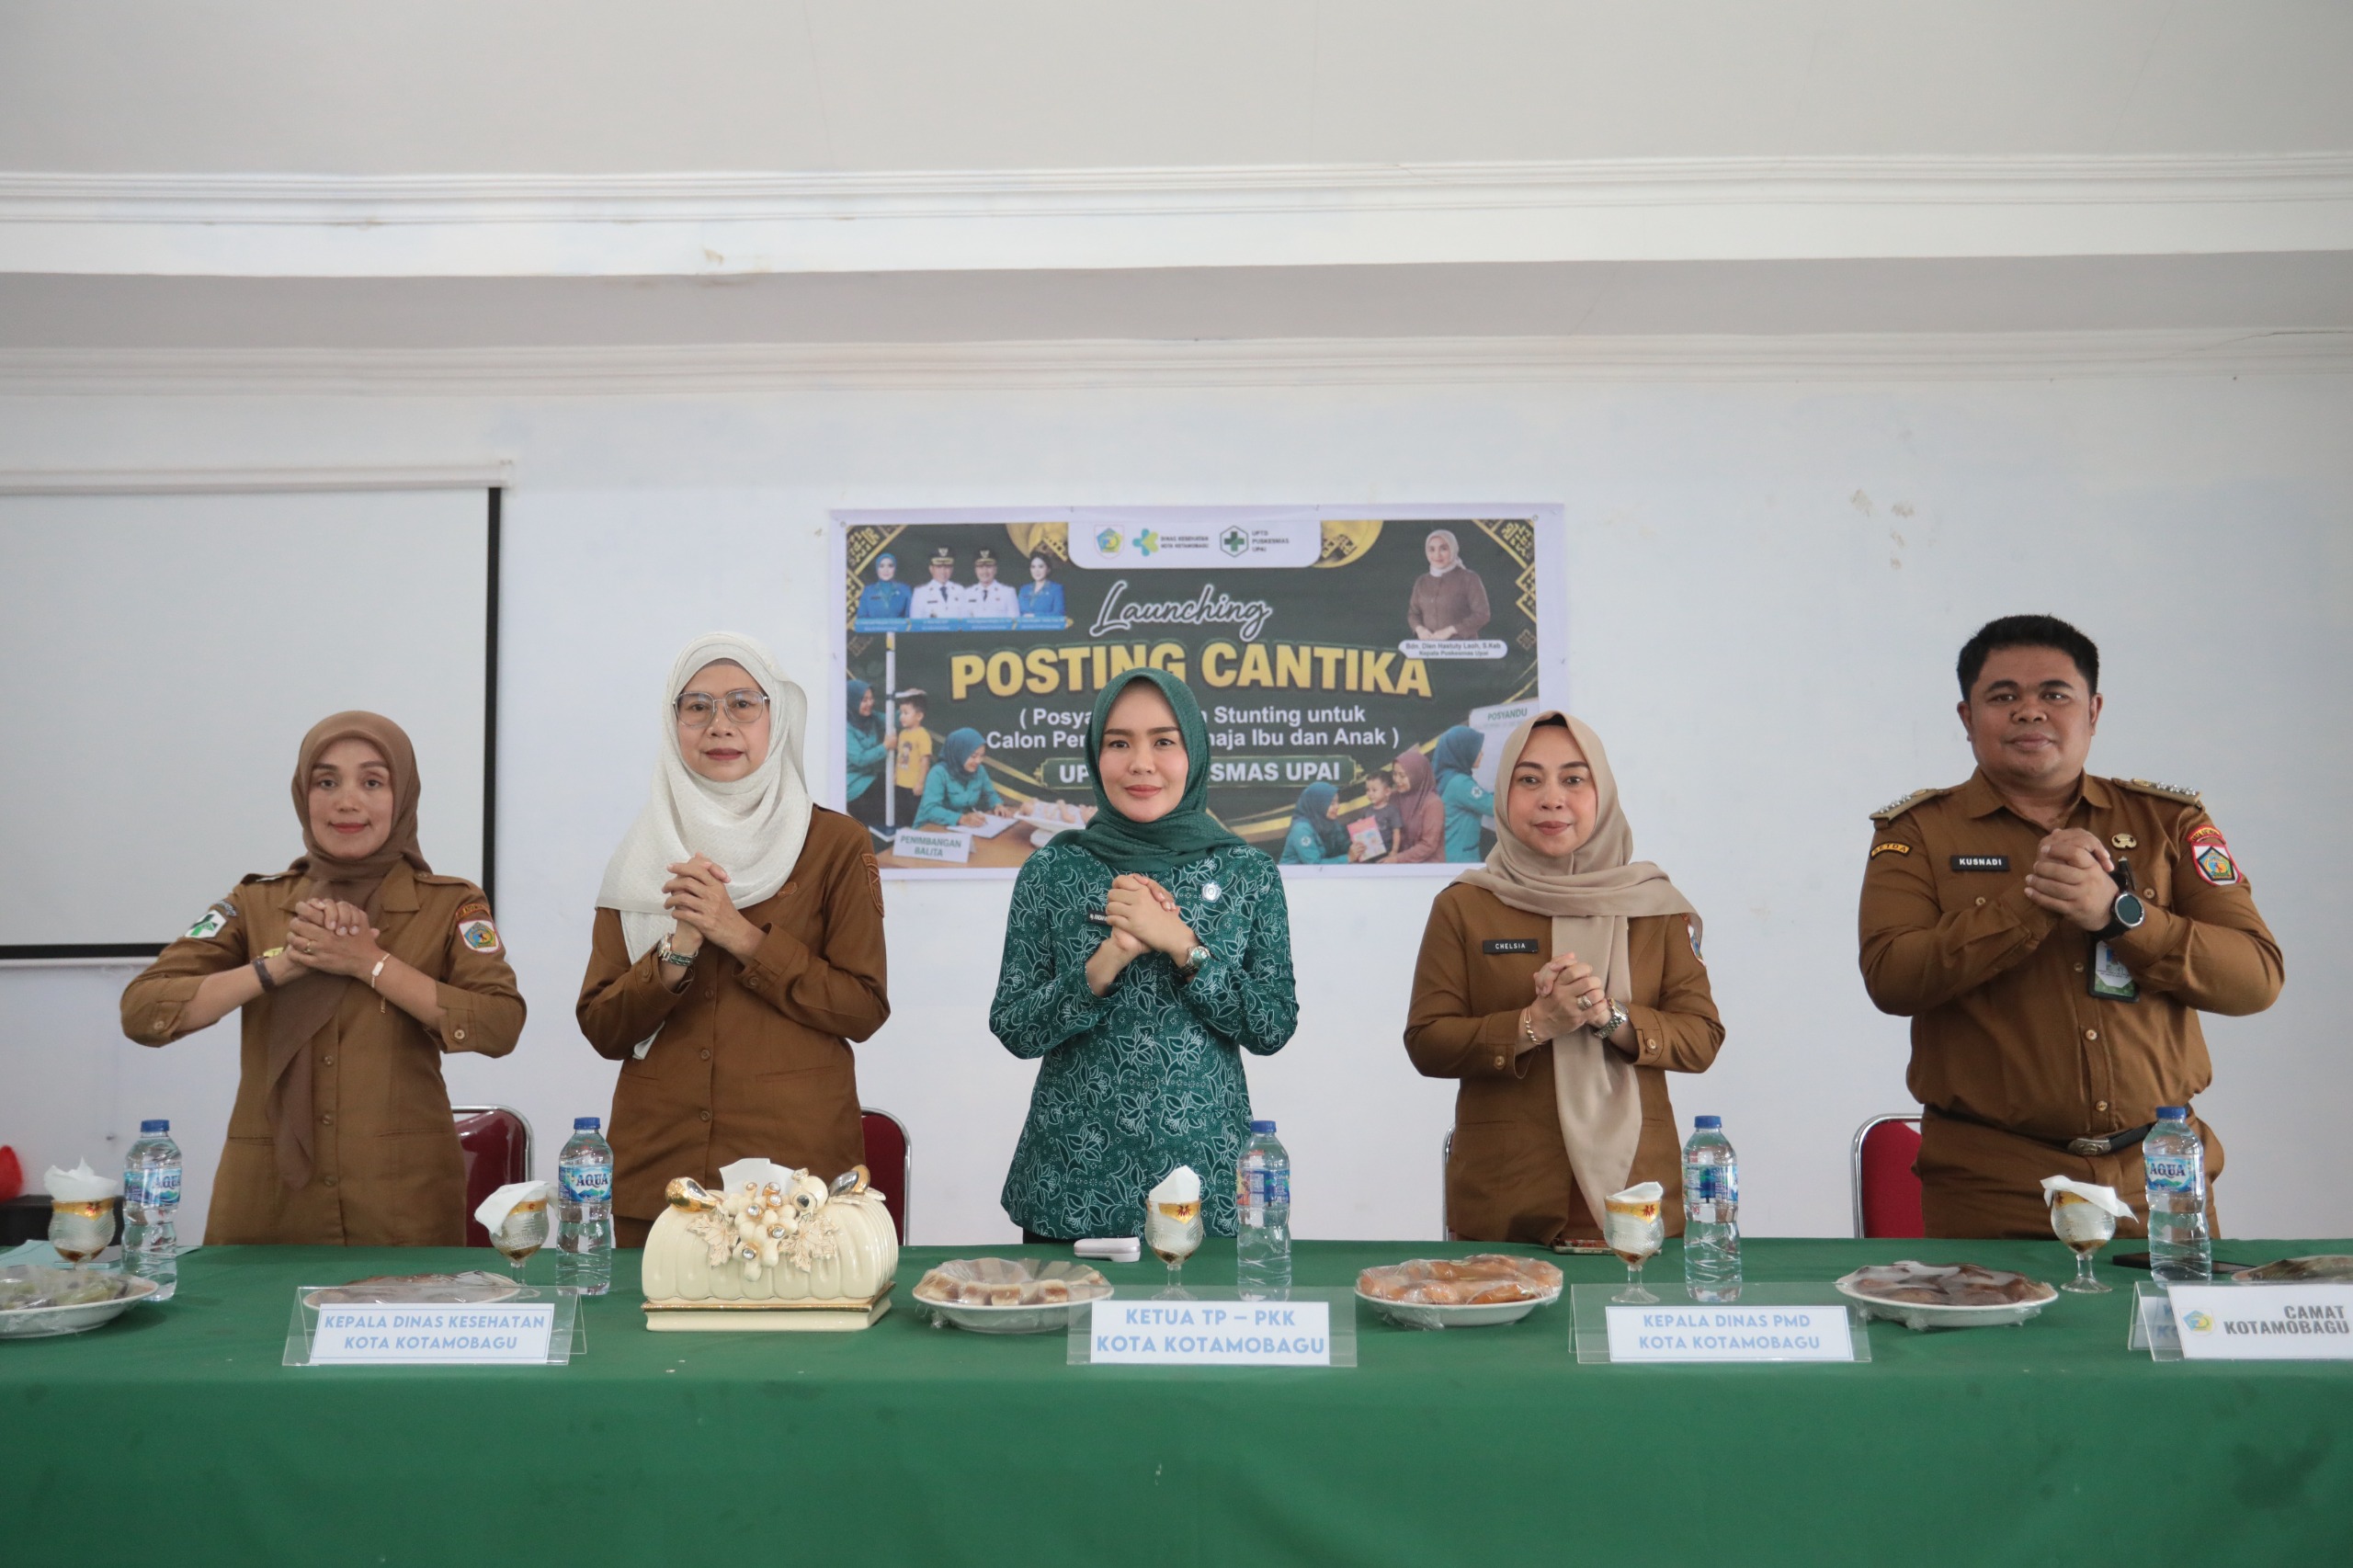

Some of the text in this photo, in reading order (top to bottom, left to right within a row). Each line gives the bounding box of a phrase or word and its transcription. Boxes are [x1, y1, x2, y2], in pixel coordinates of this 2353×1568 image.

[1089, 579, 1273, 642] Launching
[1201, 642, 1432, 698] CANTIKA
[1214, 706, 1302, 727] Stunting
[1307, 705, 1366, 723] untuk
[1487, 708, 1528, 721] POSYANDU
[986, 731, 1046, 749] Calon
[1252, 729, 1284, 746] Ibu
[1290, 728, 1328, 745] dan
[1334, 728, 1386, 745] Anak
[1286, 762, 1340, 780] UPAI
[900, 835, 962, 848] PENIMBANGAN
[915, 846, 943, 858] BALITA
[1959, 858, 2002, 866] KUSNADI
[1495, 942, 1526, 950] CHELSIA
[2150, 1163, 2186, 1178] AQUA
[575, 1173, 609, 1187] AQUA
[1126, 1309, 1195, 1325] KETUA
[1202, 1310, 1227, 1325] TP
[1255, 1310, 1296, 1326] PKK
[2283, 1305, 2345, 1320] CAMAT
[324, 1315, 545, 1329] KEPALA DINAS KESEHATAN
[1643, 1314, 1811, 1328] KEPALA DINAS PMD
[2222, 1320, 2350, 1335] KOTAMOBAGU
[344, 1336, 517, 1349] KOTA KOTAMOBAGU
[1097, 1335, 1324, 1354] KOTA KOTAMOBAGU
[1639, 1335, 1820, 1349] KOTA KOTAMOBAGU
